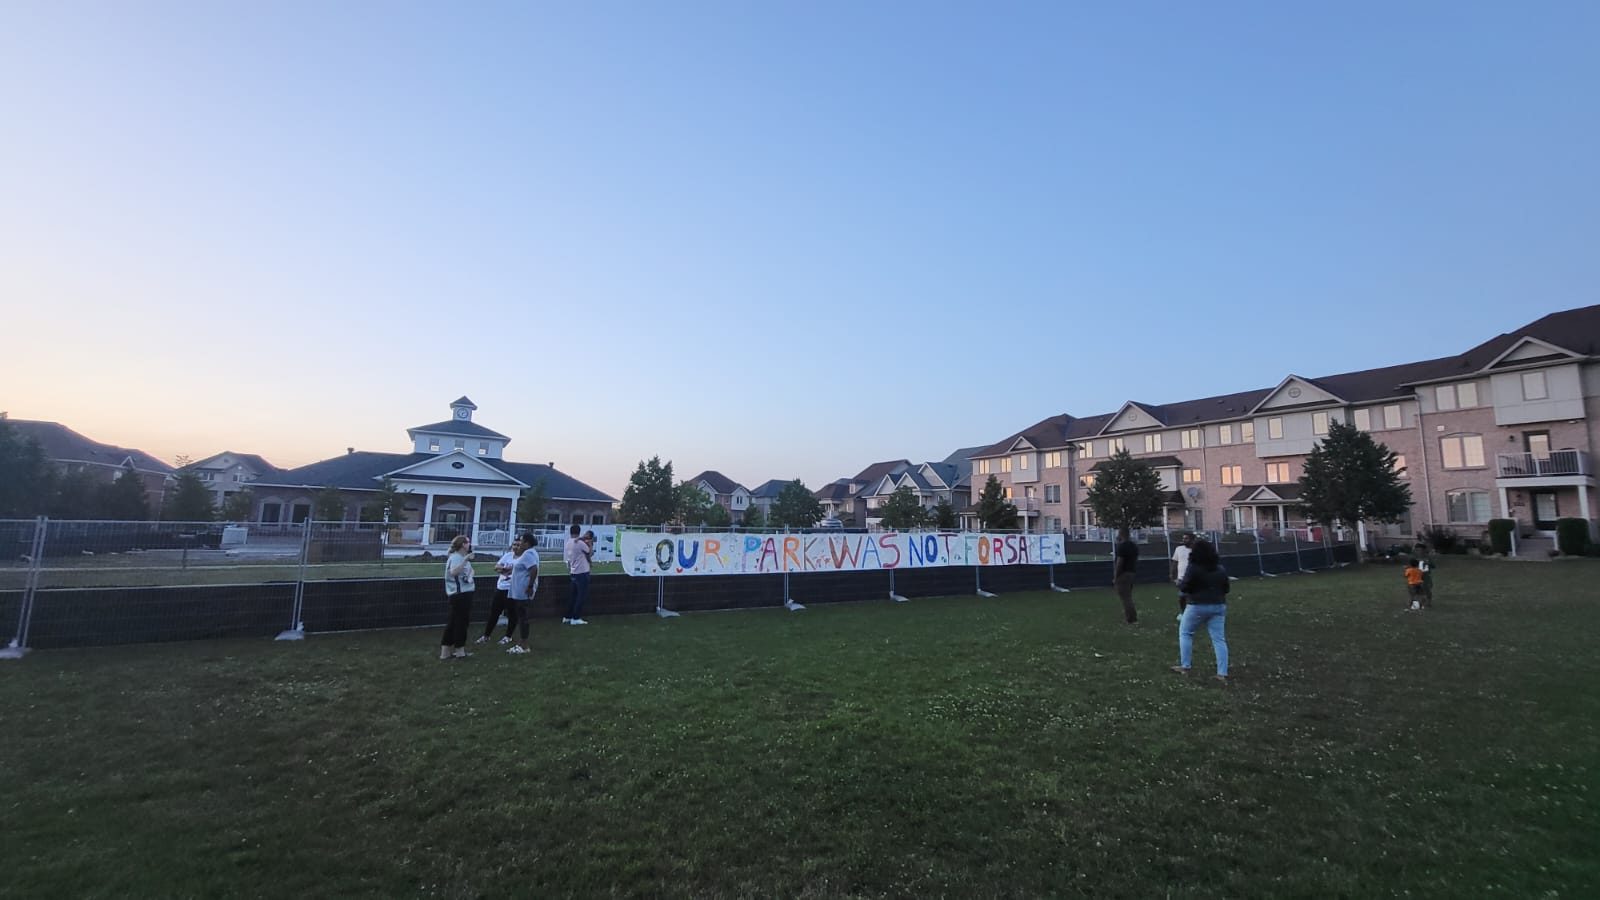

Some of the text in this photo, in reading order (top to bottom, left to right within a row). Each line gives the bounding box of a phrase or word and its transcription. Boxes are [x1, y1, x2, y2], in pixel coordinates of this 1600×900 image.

[656, 539, 724, 571] OUR
[741, 536, 818, 572] PARK
[828, 533, 901, 569] WAS
[909, 534, 958, 566] NOT
